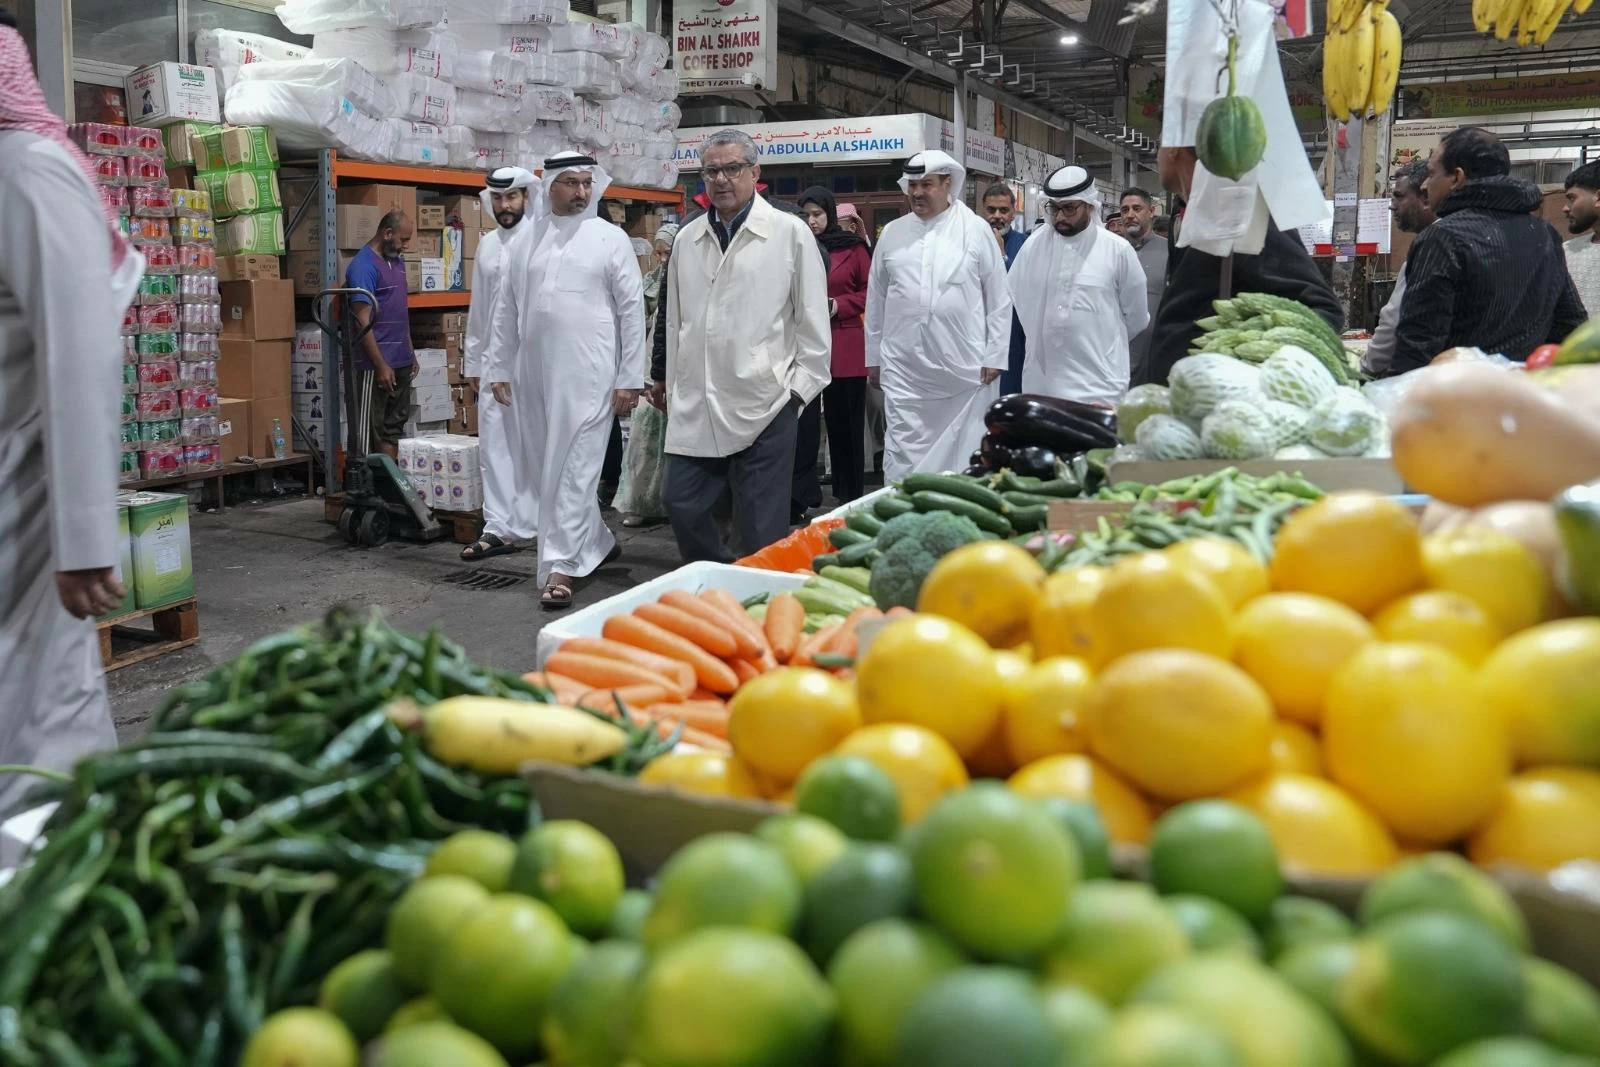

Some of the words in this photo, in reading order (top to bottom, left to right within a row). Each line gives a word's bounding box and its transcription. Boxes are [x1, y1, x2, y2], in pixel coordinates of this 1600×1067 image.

[678, 15, 709, 31] الشيخ
[724, 12, 760, 28] مقهى
[677, 36, 696, 52] BIN
[700, 35, 714, 50] AL
[717, 31, 760, 50] SHAIKH
[683, 54, 719, 71] COFFE
[722, 52, 754, 69] SHOP
[767, 142, 830, 155] ABDULLA
[833, 138, 904, 152] ALSHAIKH
[300, 339, 321, 350] Amul
